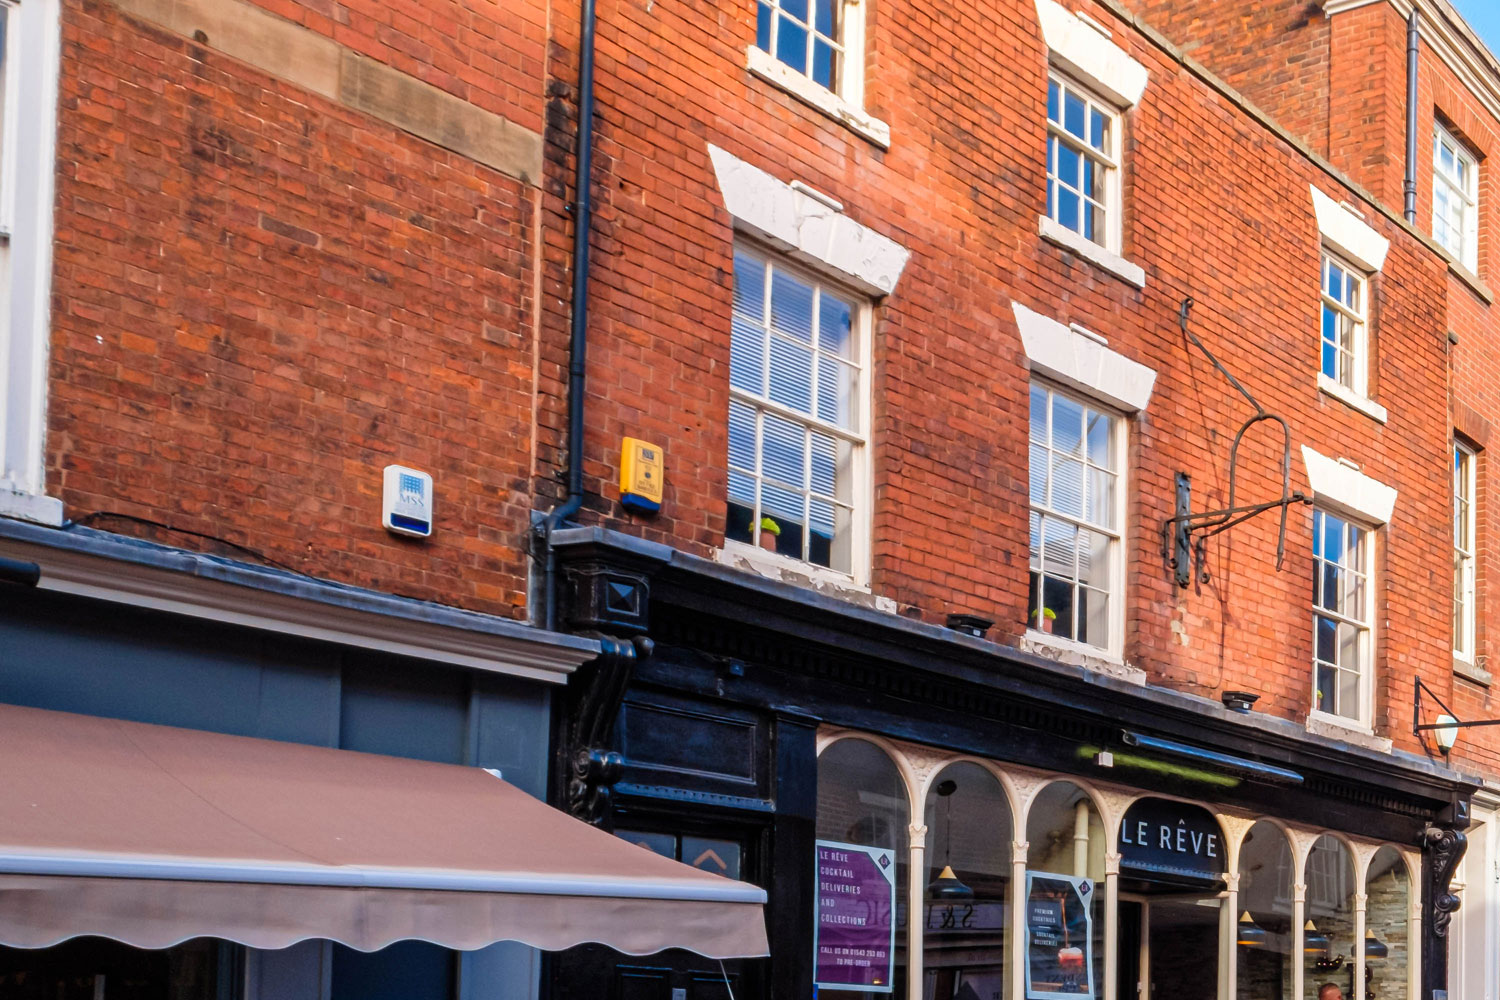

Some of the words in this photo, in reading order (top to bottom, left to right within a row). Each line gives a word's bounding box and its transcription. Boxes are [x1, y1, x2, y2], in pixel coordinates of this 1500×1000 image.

[1122, 818, 1148, 846] LE
[1159, 818, 1217, 857] RÊVE
[820, 850, 828, 860] LE
[820, 867, 854, 879] COCKTAIL
[820, 882, 861, 895] DELIVERIES
[820, 899, 835, 908] AND
[820, 914, 866, 926] COLLECTIONS
